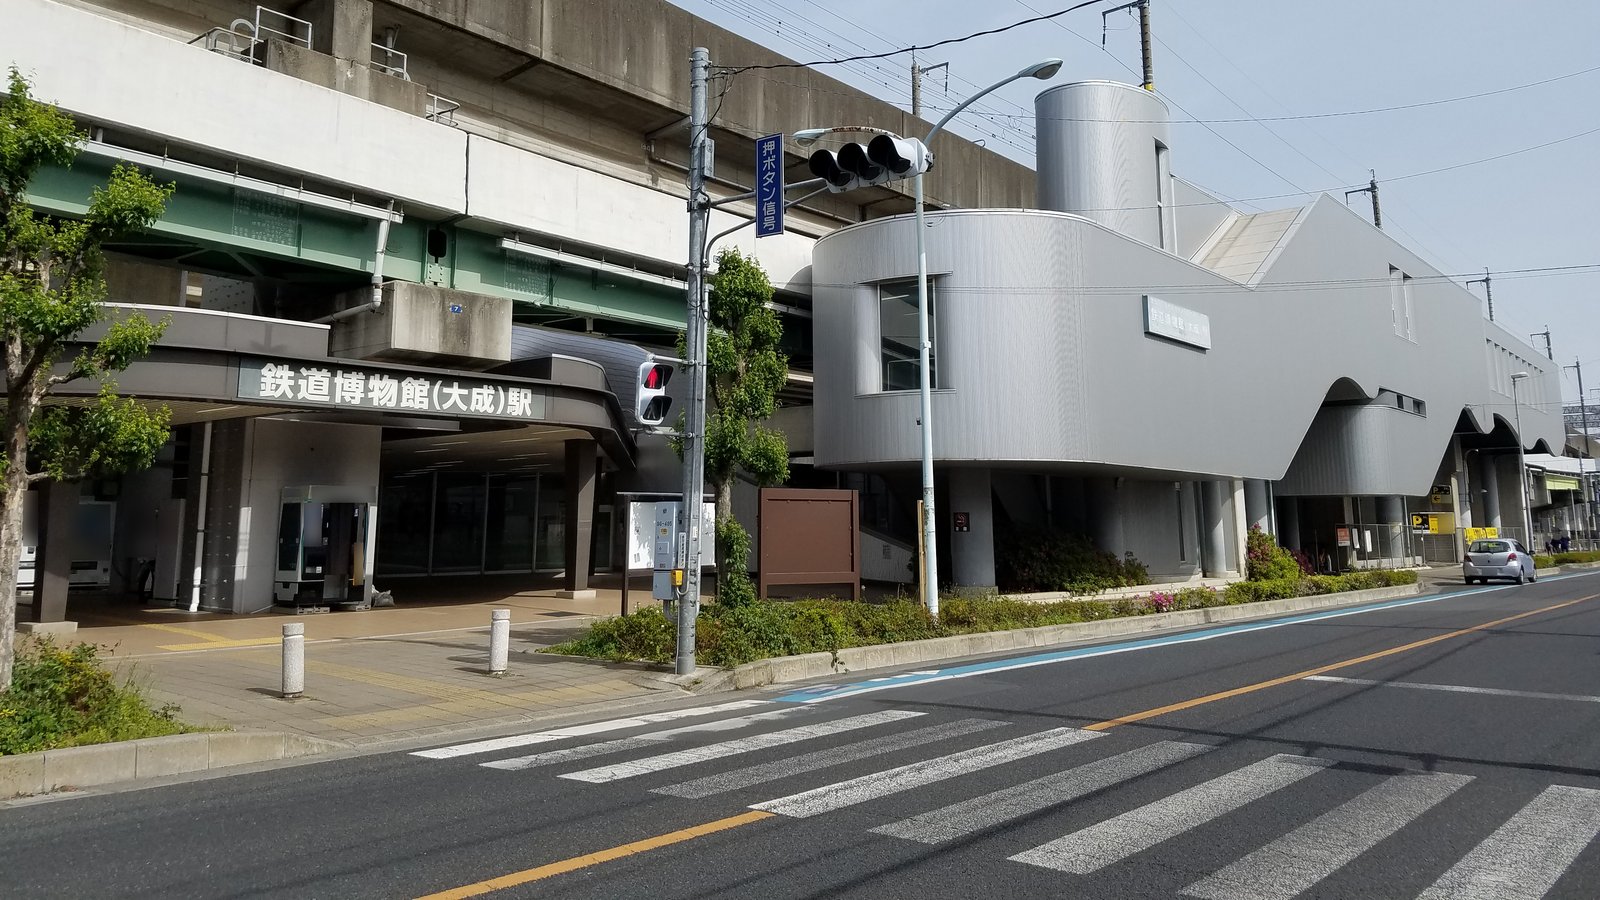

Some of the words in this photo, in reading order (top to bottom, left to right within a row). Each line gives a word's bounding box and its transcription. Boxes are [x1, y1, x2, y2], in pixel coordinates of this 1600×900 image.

[762, 140, 776, 231] 押ボタン信号
[259, 362, 533, 417] 鉄道博物館(大成)駅
